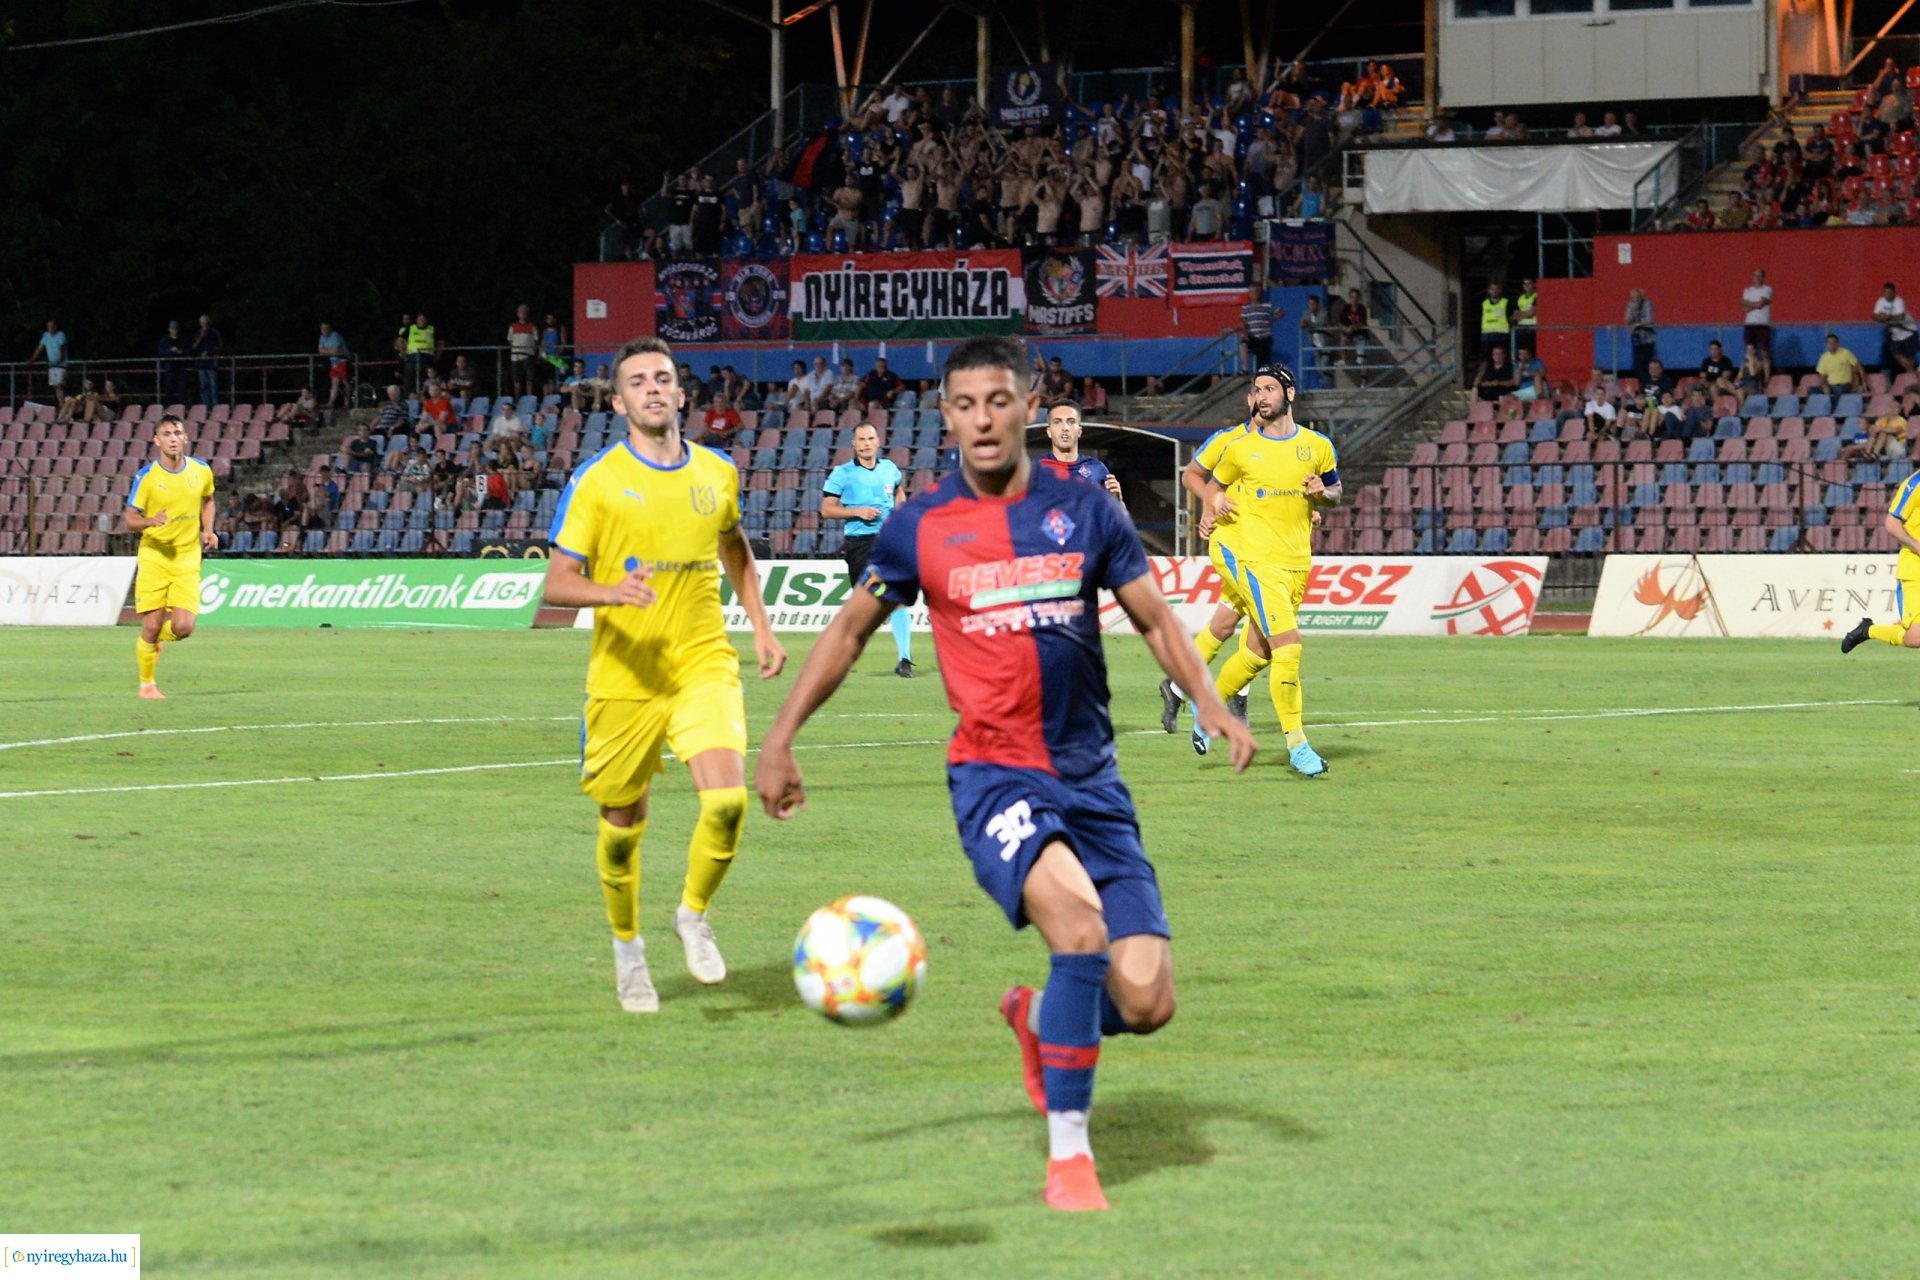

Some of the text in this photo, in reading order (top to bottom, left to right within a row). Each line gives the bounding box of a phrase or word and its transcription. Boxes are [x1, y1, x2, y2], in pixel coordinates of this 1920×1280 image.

[803, 259, 1011, 321] NYÍREGYHÁZA
[1027, 303, 1095, 325] MASTIFFS
[229, 572, 531, 609] merkantilbank LIGA
[1311, 615, 1351, 626] RIGHT
[1352, 615, 1382, 626] WAY
[985, 799, 1037, 863] 30
